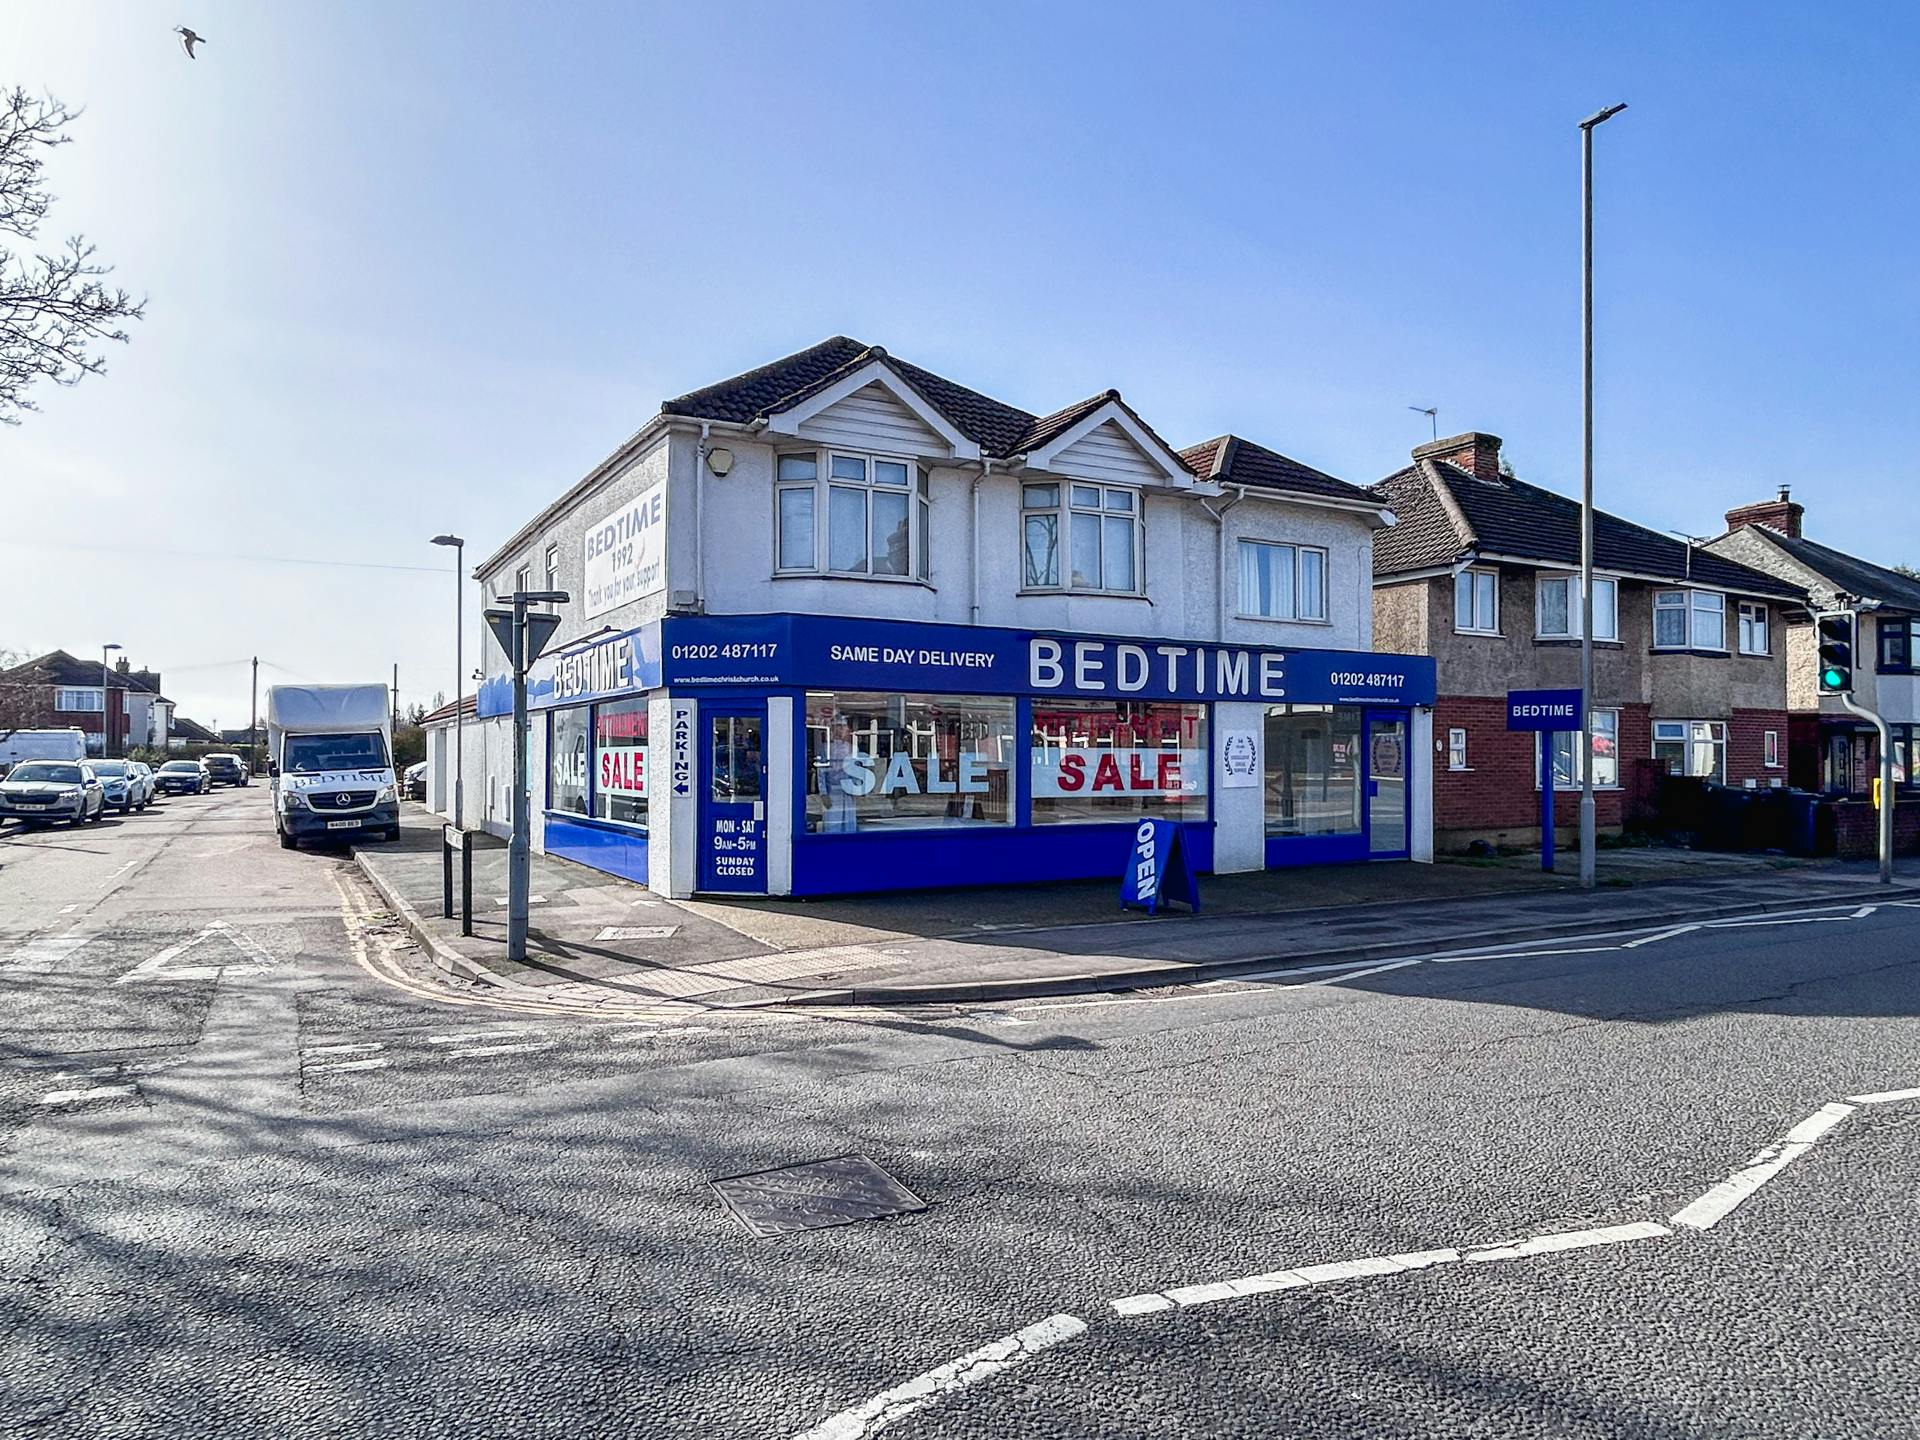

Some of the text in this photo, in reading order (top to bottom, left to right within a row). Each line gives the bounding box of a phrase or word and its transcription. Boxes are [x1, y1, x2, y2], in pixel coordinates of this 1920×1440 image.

[587, 493, 661, 562] BEDTIME
[611, 542, 633, 573] 1992
[672, 644, 777, 659] 01202 487117
[831, 645, 995, 668] SAME DAY DELIVERY
[1030, 638, 1285, 697] BEDTIME
[553, 638, 629, 699] BEDTIME
[1330, 672, 1405, 688] 01202 487117
[1512, 704, 1574, 717] BEDTIME
[675, 710, 689, 781] PARKING
[294, 774, 389, 789] BEDTIME
[556, 752, 585, 787] SALE
[602, 752, 644, 791] SALE
[841, 751, 990, 796] SALE
[1058, 753, 1182, 791] SALE
[716, 820, 735, 833] MON
[741, 820, 755, 833] SAT
[716, 856, 755, 866] SUNDAY
[716, 866, 754, 876] CLOSED
[1137, 821, 1156, 900] OPEN
